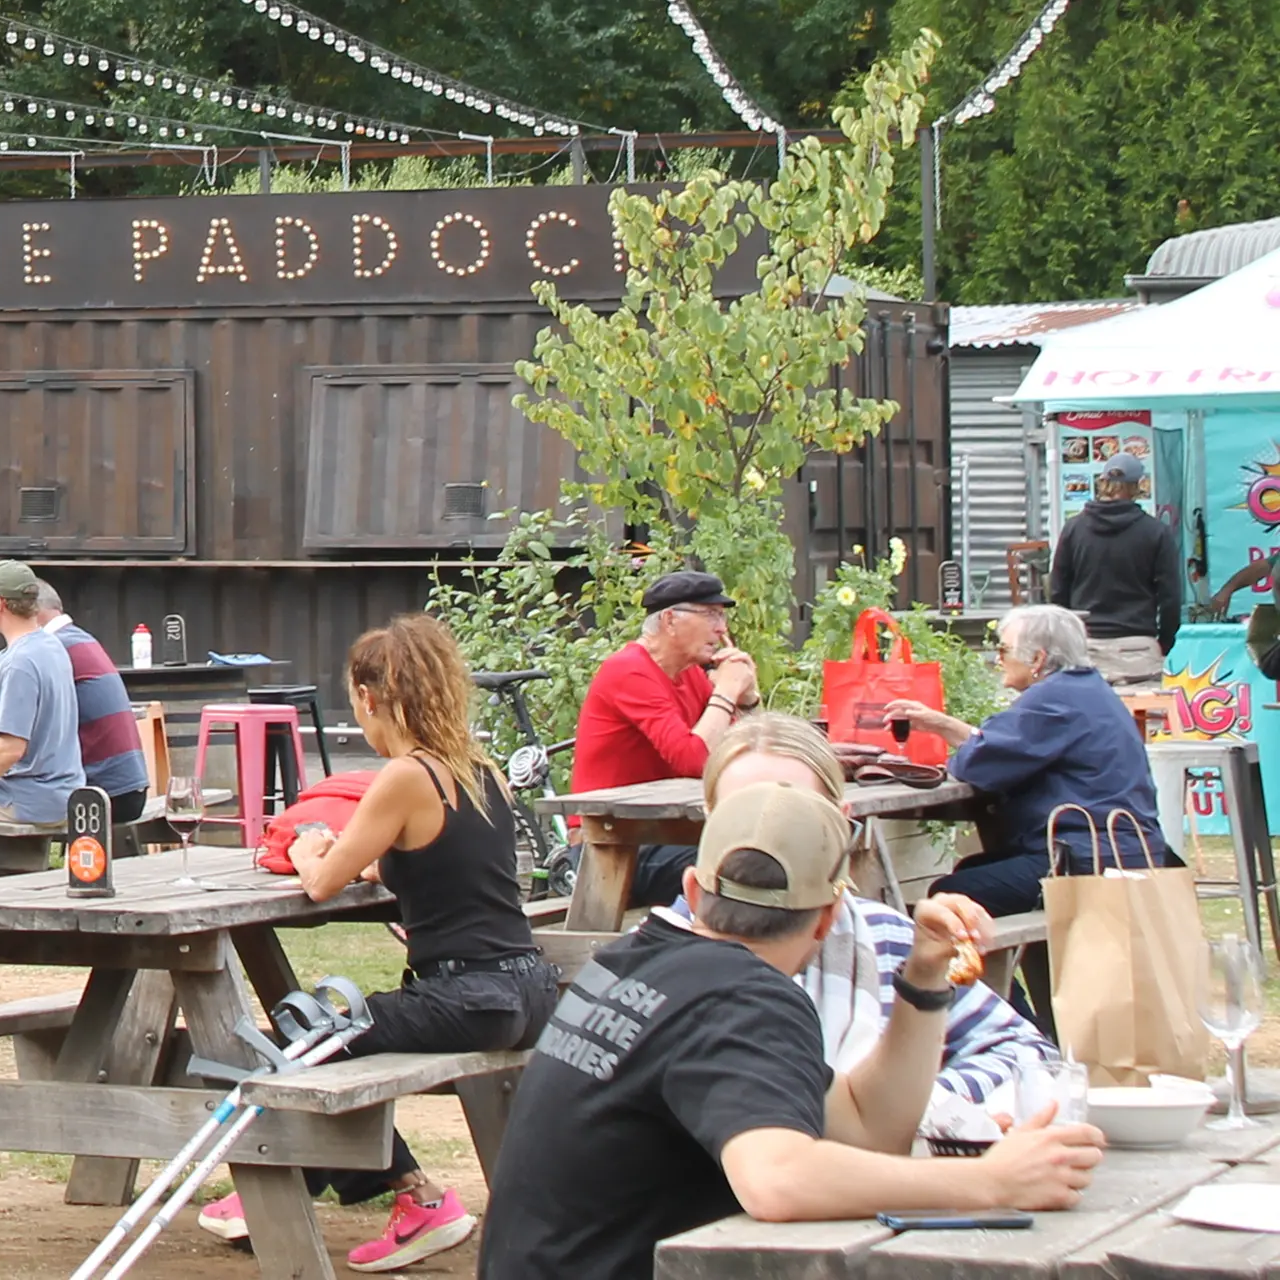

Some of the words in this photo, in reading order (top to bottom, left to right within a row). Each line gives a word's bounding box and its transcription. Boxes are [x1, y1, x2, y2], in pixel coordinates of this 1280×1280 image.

[1042, 370, 1169, 386] HOT
[166, 620, 182, 641] 102
[75, 803, 100, 834] 88
[585, 1004, 644, 1051] THE
